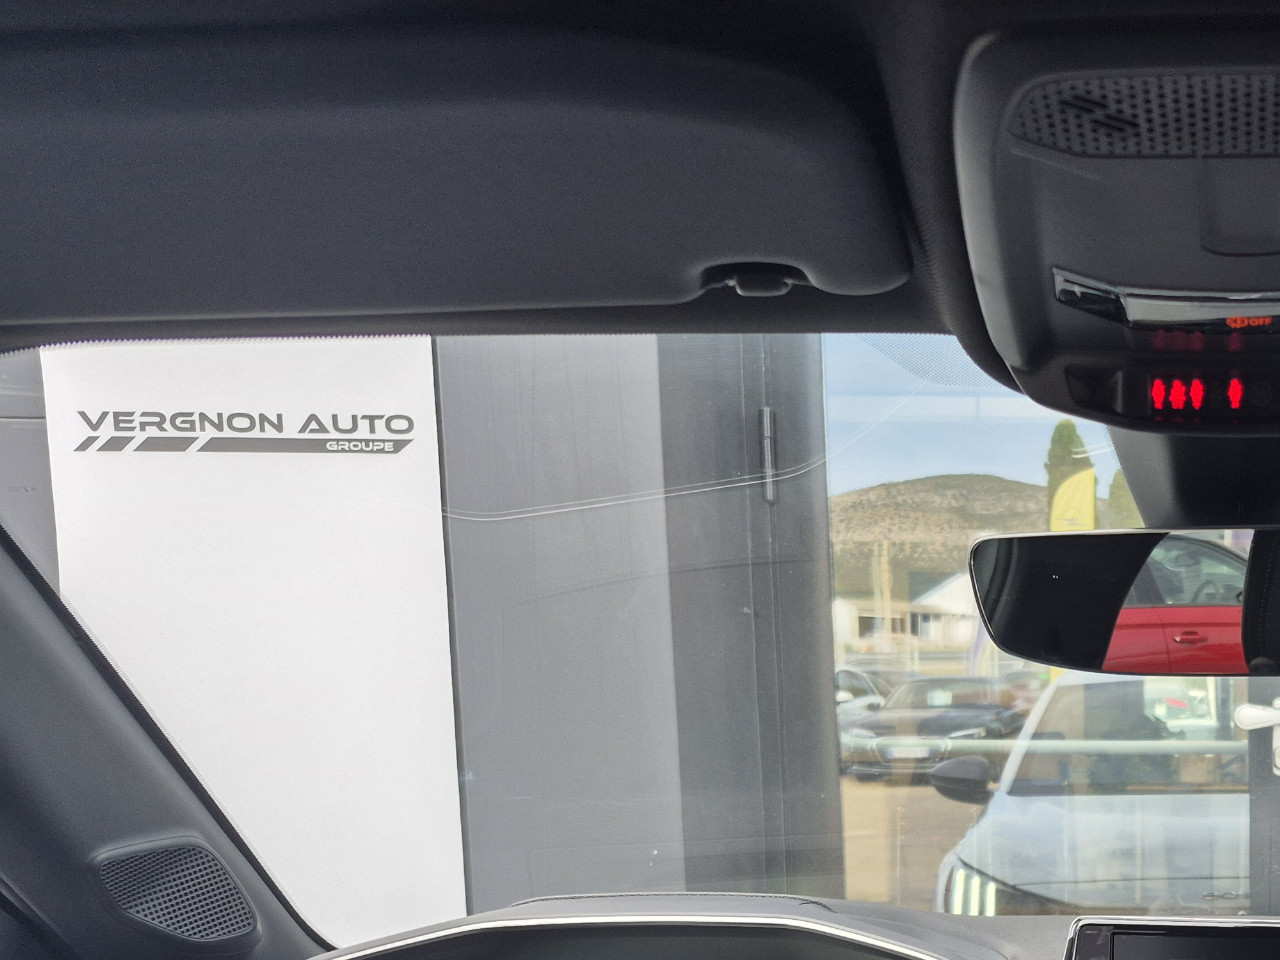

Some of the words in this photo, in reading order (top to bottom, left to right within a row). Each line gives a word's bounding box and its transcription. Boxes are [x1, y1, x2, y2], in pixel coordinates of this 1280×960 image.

[76, 411, 284, 433] VERGNON
[297, 413, 415, 435] AUTO
[326, 441, 394, 452] GROUPE
